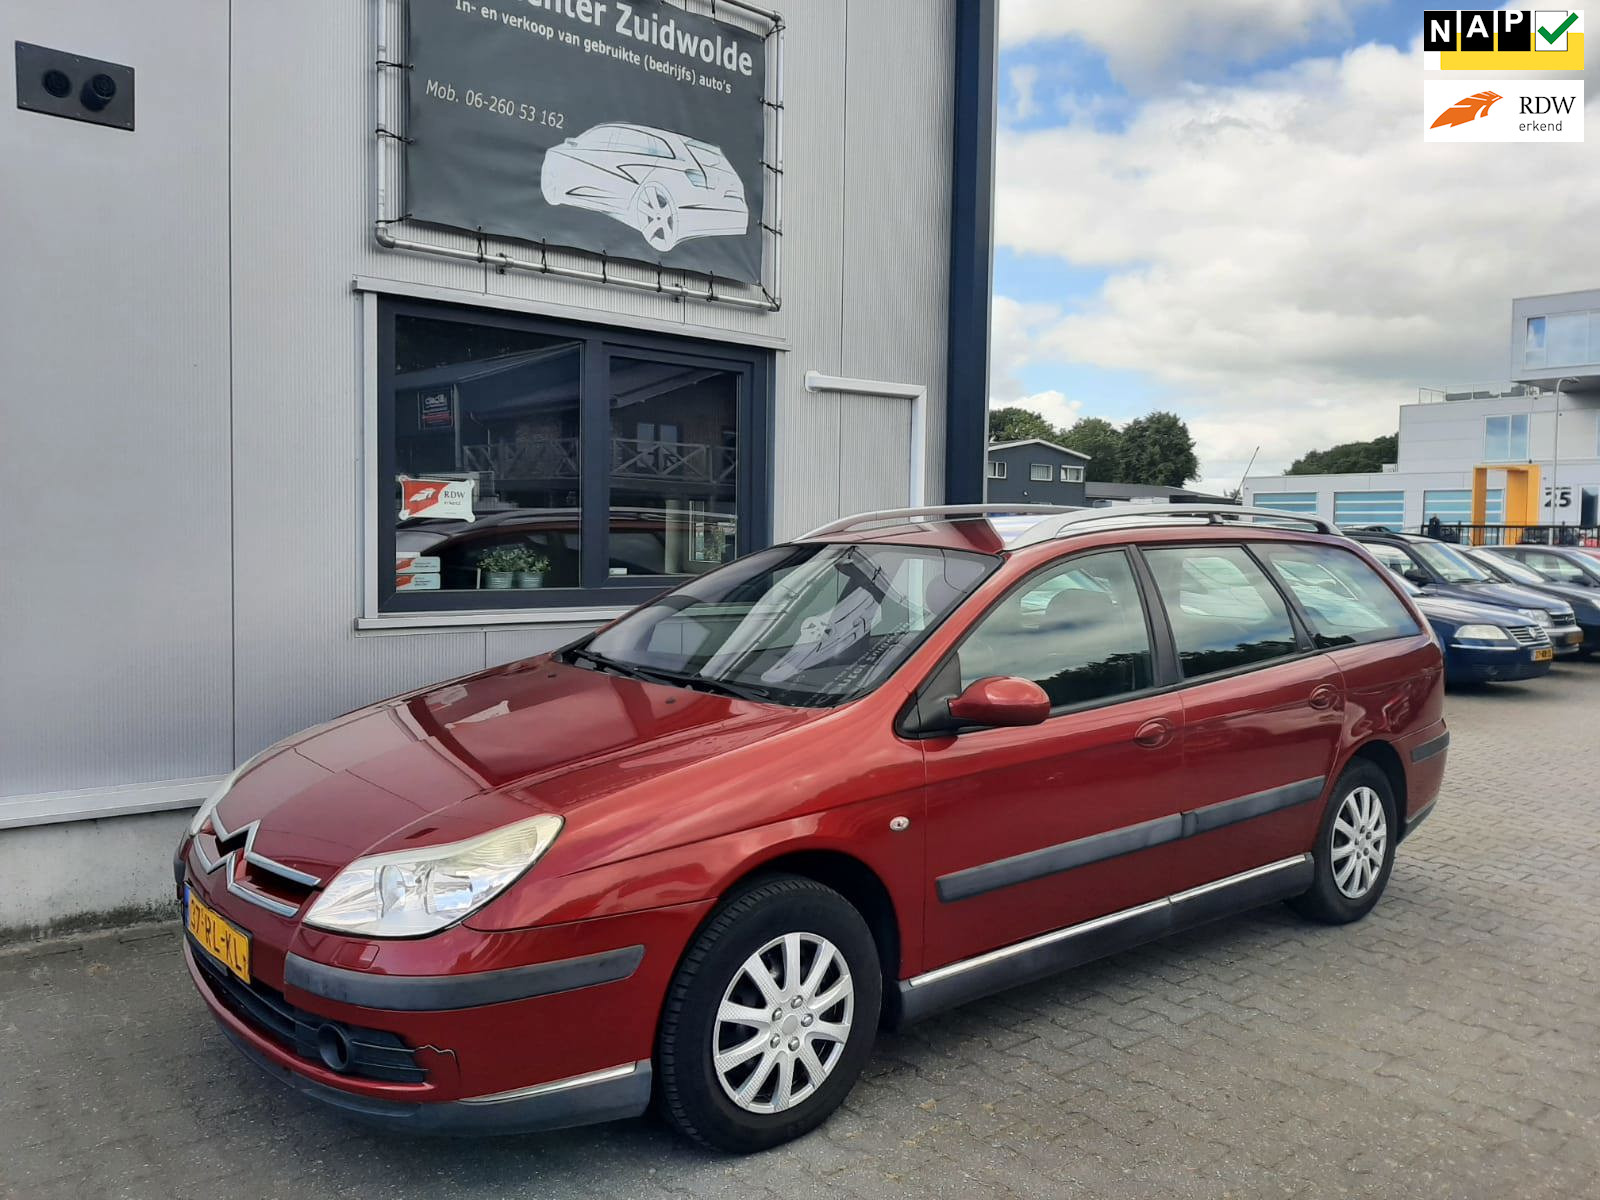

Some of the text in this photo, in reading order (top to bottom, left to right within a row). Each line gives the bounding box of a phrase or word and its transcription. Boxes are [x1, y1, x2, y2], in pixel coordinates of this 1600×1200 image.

[455, 0, 732, 94] In- en verkoop van gebruikte (bedrijfs) auto's
[615, 2, 753, 76] Zuidwolde
[425, 79, 564, 129] Mob. 06-260 53 162
[444, 490, 466, 499] RDW
[1544, 491, 1572, 508] 25
